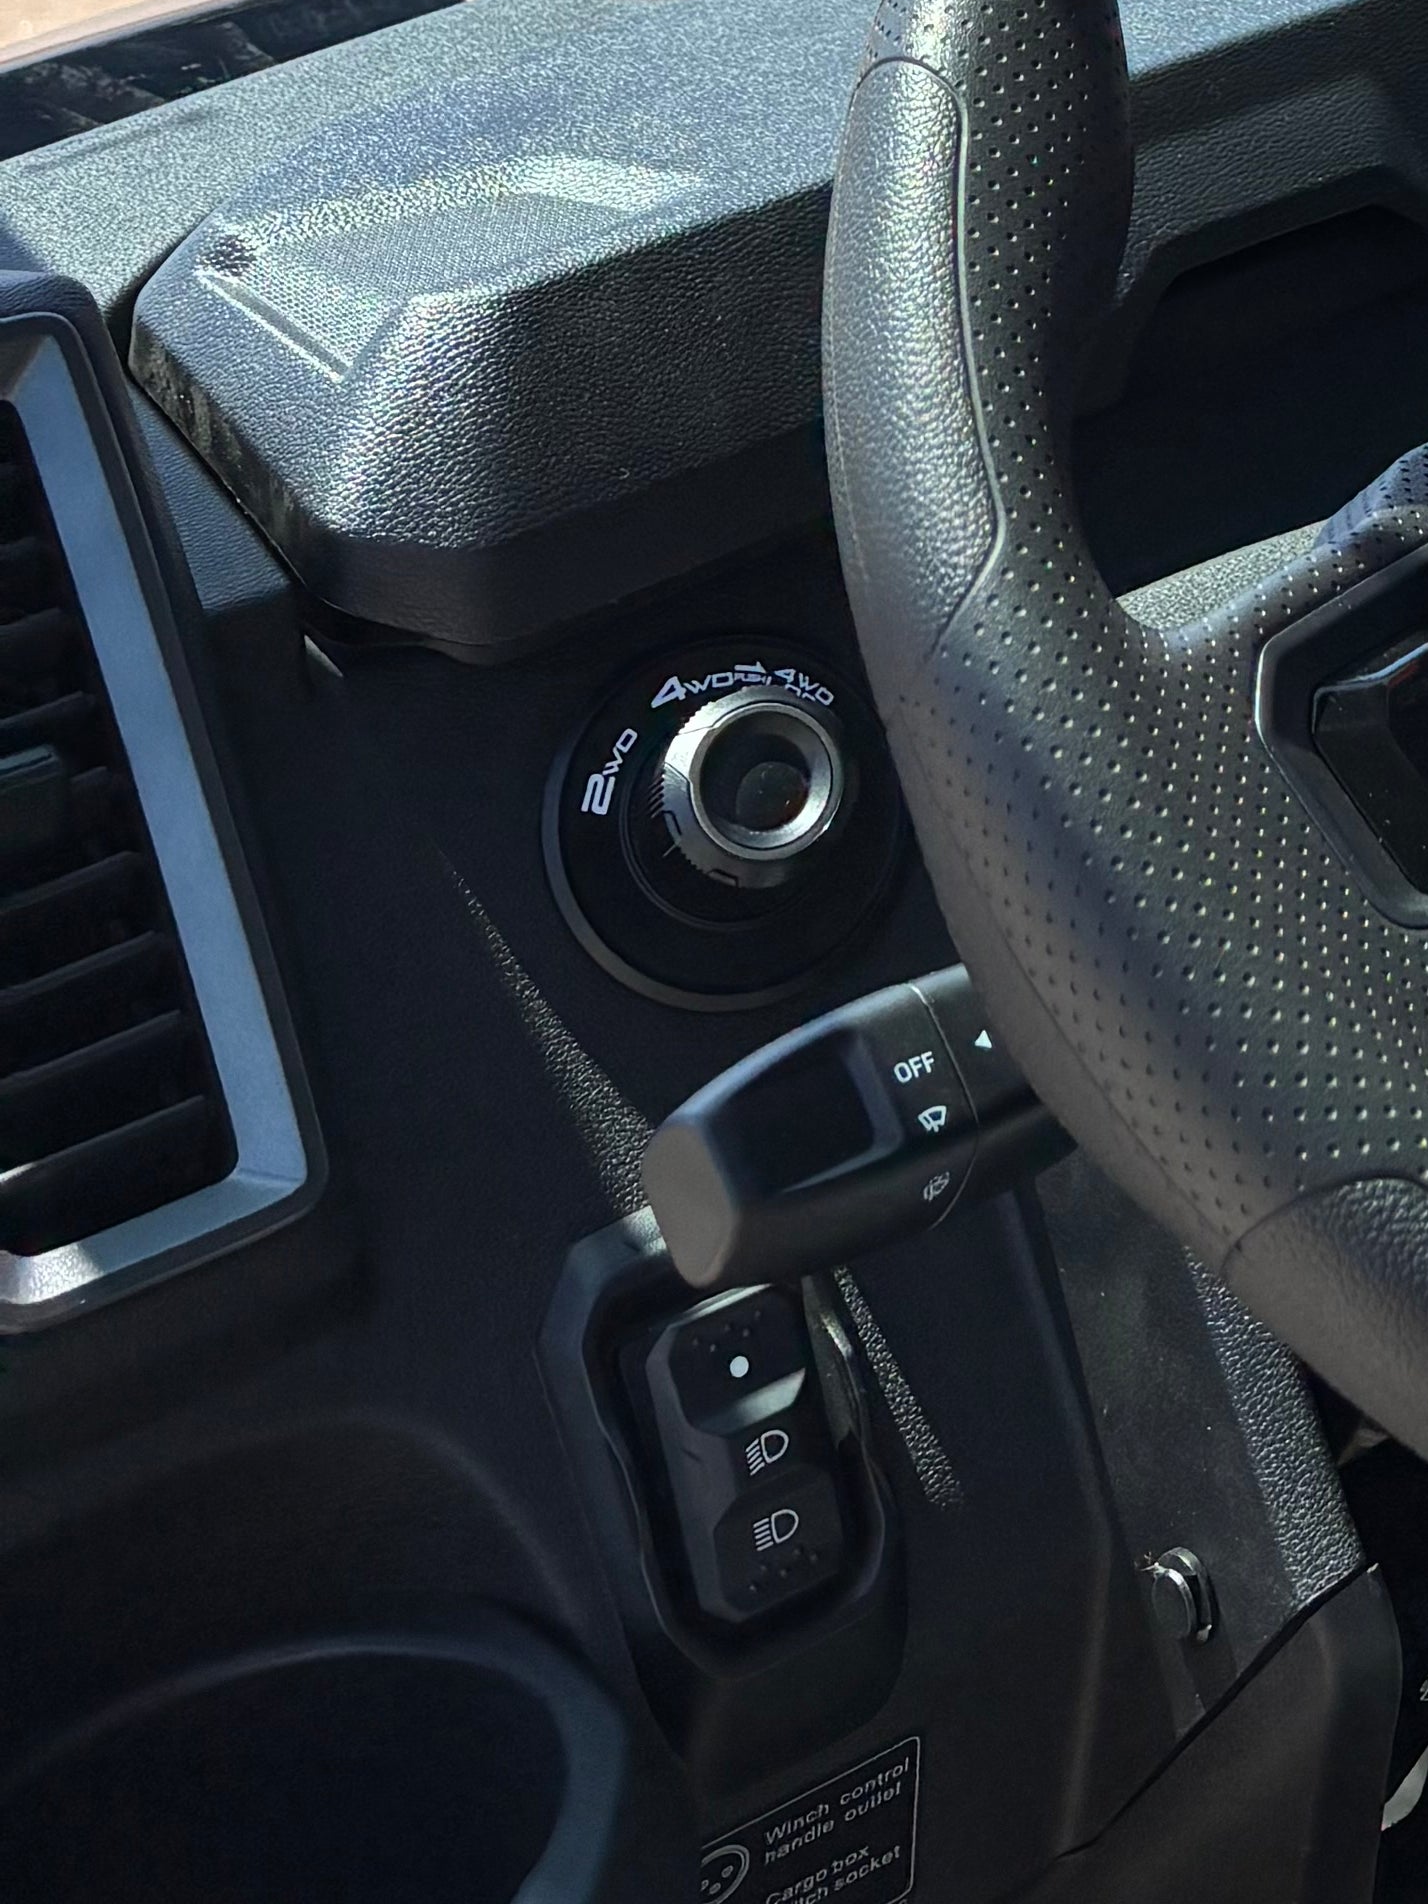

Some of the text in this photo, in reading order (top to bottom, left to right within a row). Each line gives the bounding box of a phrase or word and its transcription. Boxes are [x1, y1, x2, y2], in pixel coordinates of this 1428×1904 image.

[650, 672, 736, 710] 4WD
[773, 667, 835, 706] 4WD
[580, 726, 640, 817] 2WD
[892, 1049, 937, 1085] OFF
[764, 1756, 910, 1845] Winch control
[764, 1781, 901, 1865] handle outlet
[765, 1845, 870, 1904] Cargo box
[834, 1844, 901, 1891] socket
